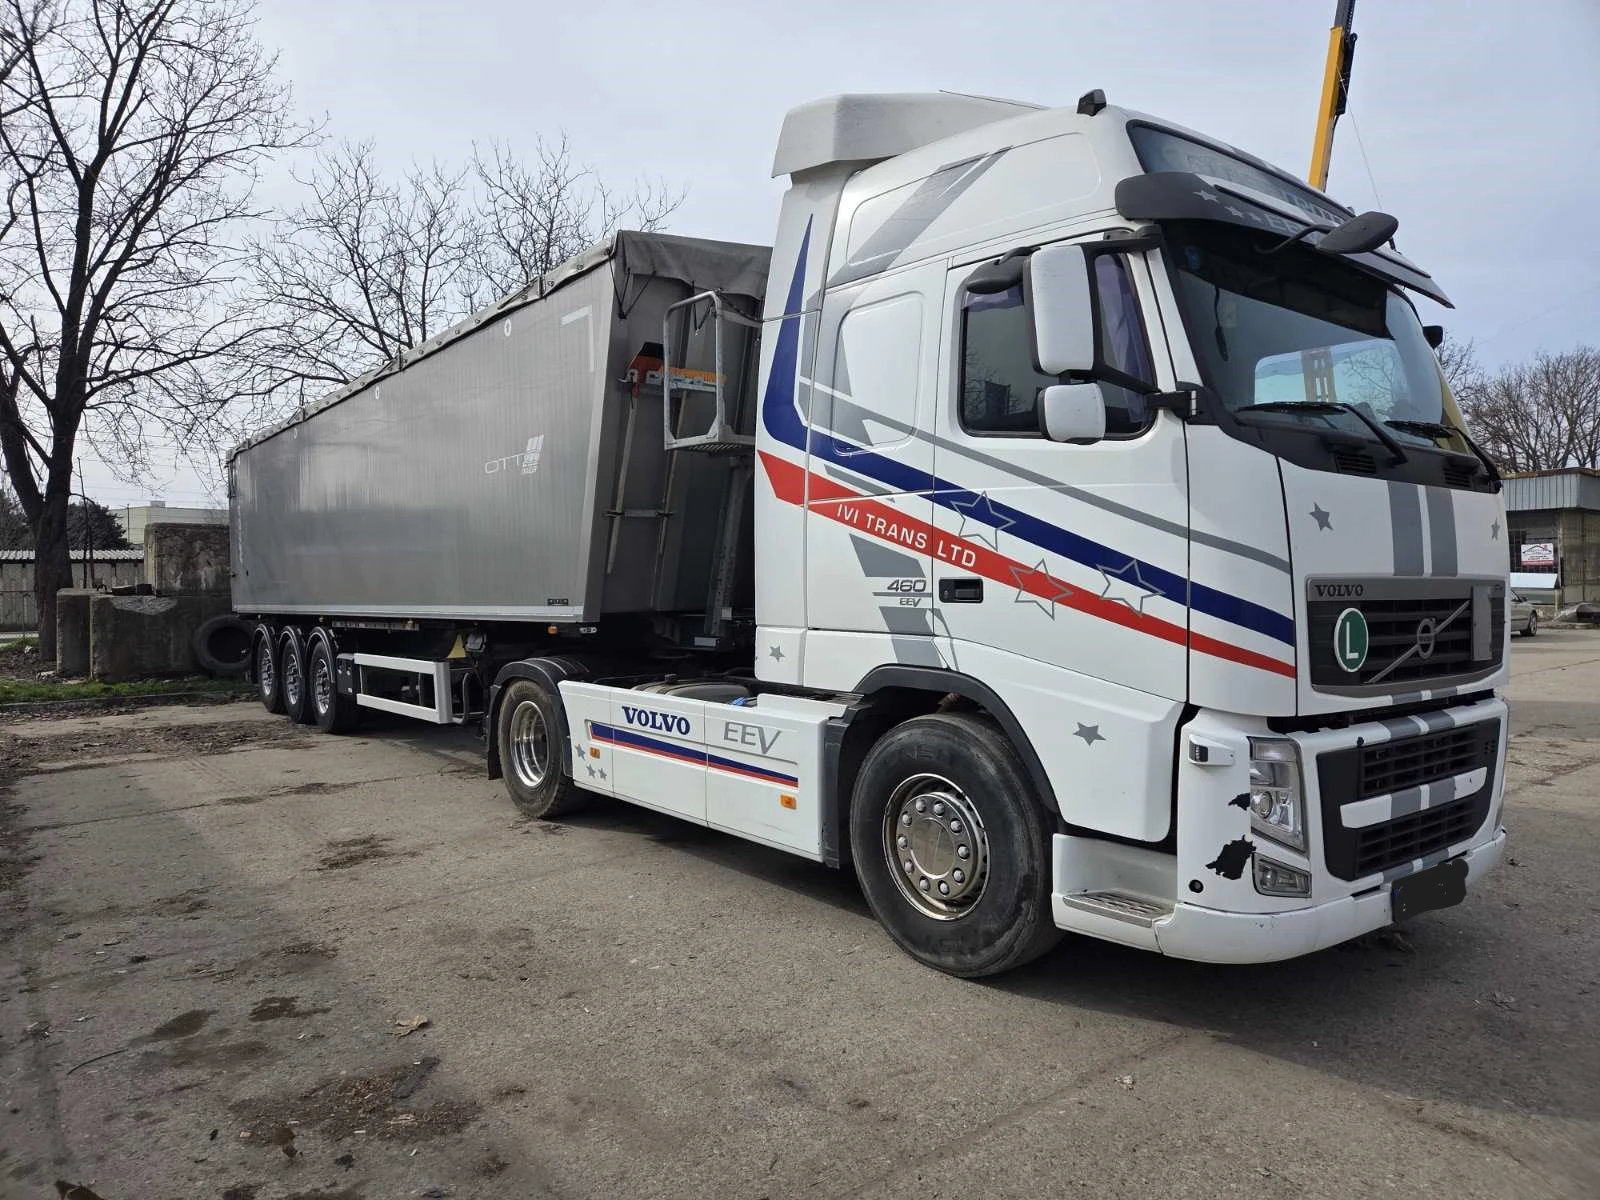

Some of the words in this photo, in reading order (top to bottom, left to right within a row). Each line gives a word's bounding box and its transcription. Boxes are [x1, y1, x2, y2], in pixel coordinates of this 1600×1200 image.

[837, 503, 859, 524] IVI
[866, 513, 928, 549] TRANS
[937, 540, 976, 567] LTD
[887, 579, 927, 592] 460
[1315, 584, 1364, 597] VOLVO
[899, 597, 922, 607] EEV
[1346, 622, 1359, 659] L
[622, 705, 691, 736] VOLVO
[723, 721, 783, 754] EEV
